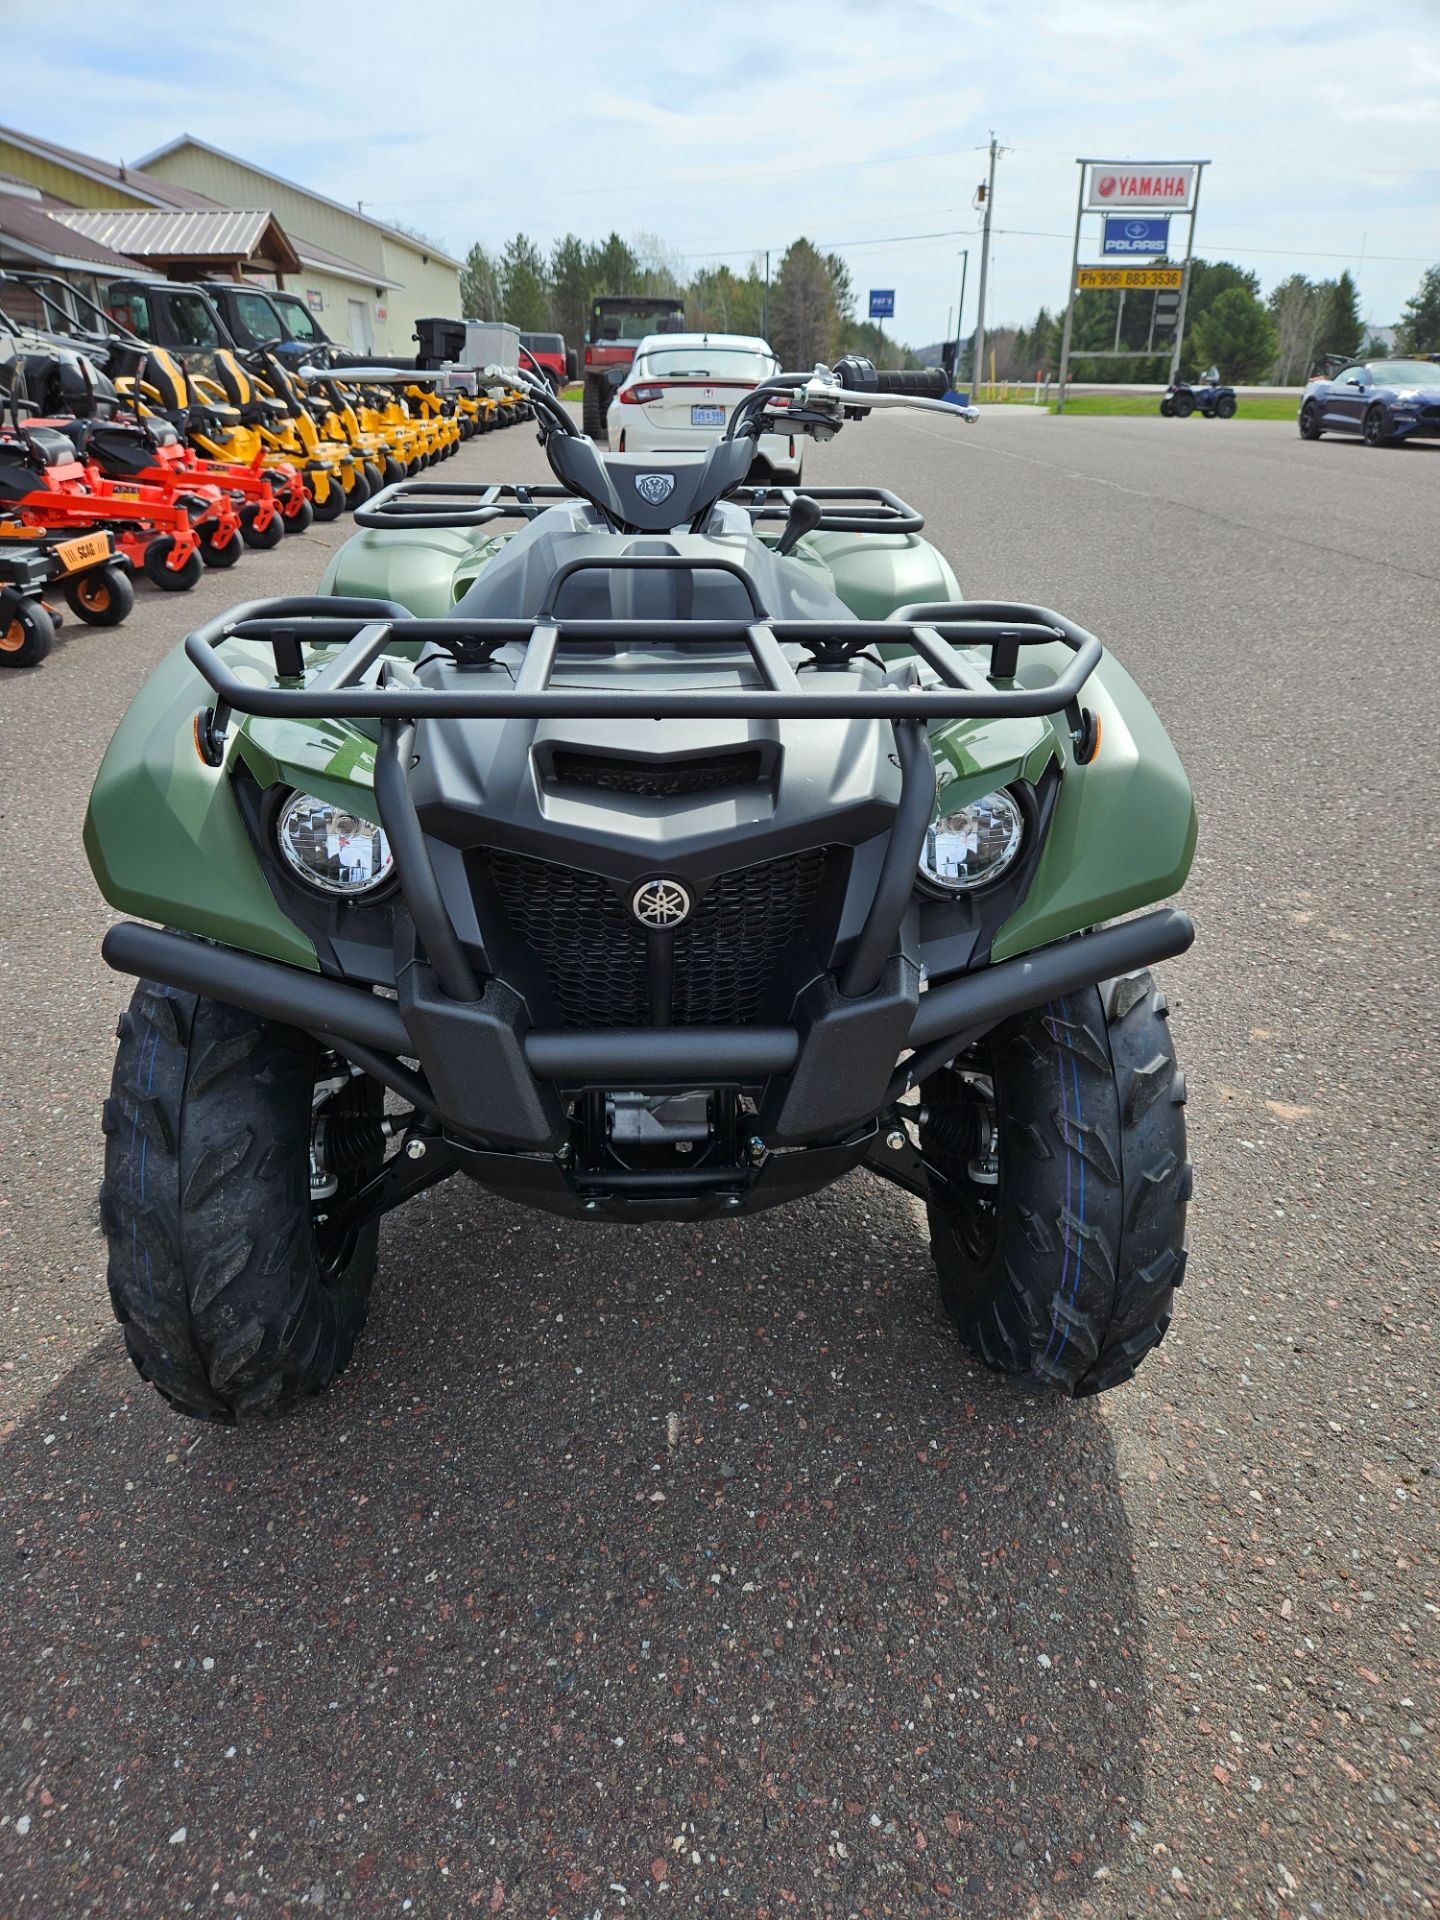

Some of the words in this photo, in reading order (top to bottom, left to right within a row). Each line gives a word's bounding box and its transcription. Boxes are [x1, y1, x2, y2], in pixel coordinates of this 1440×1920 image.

[1119, 176, 1185, 196] YAMAHA
[1104, 240, 1166, 250] POLARIS
[1081, 272, 1096, 285] Ph
[1126, 272, 1178, 285] 883-3536
